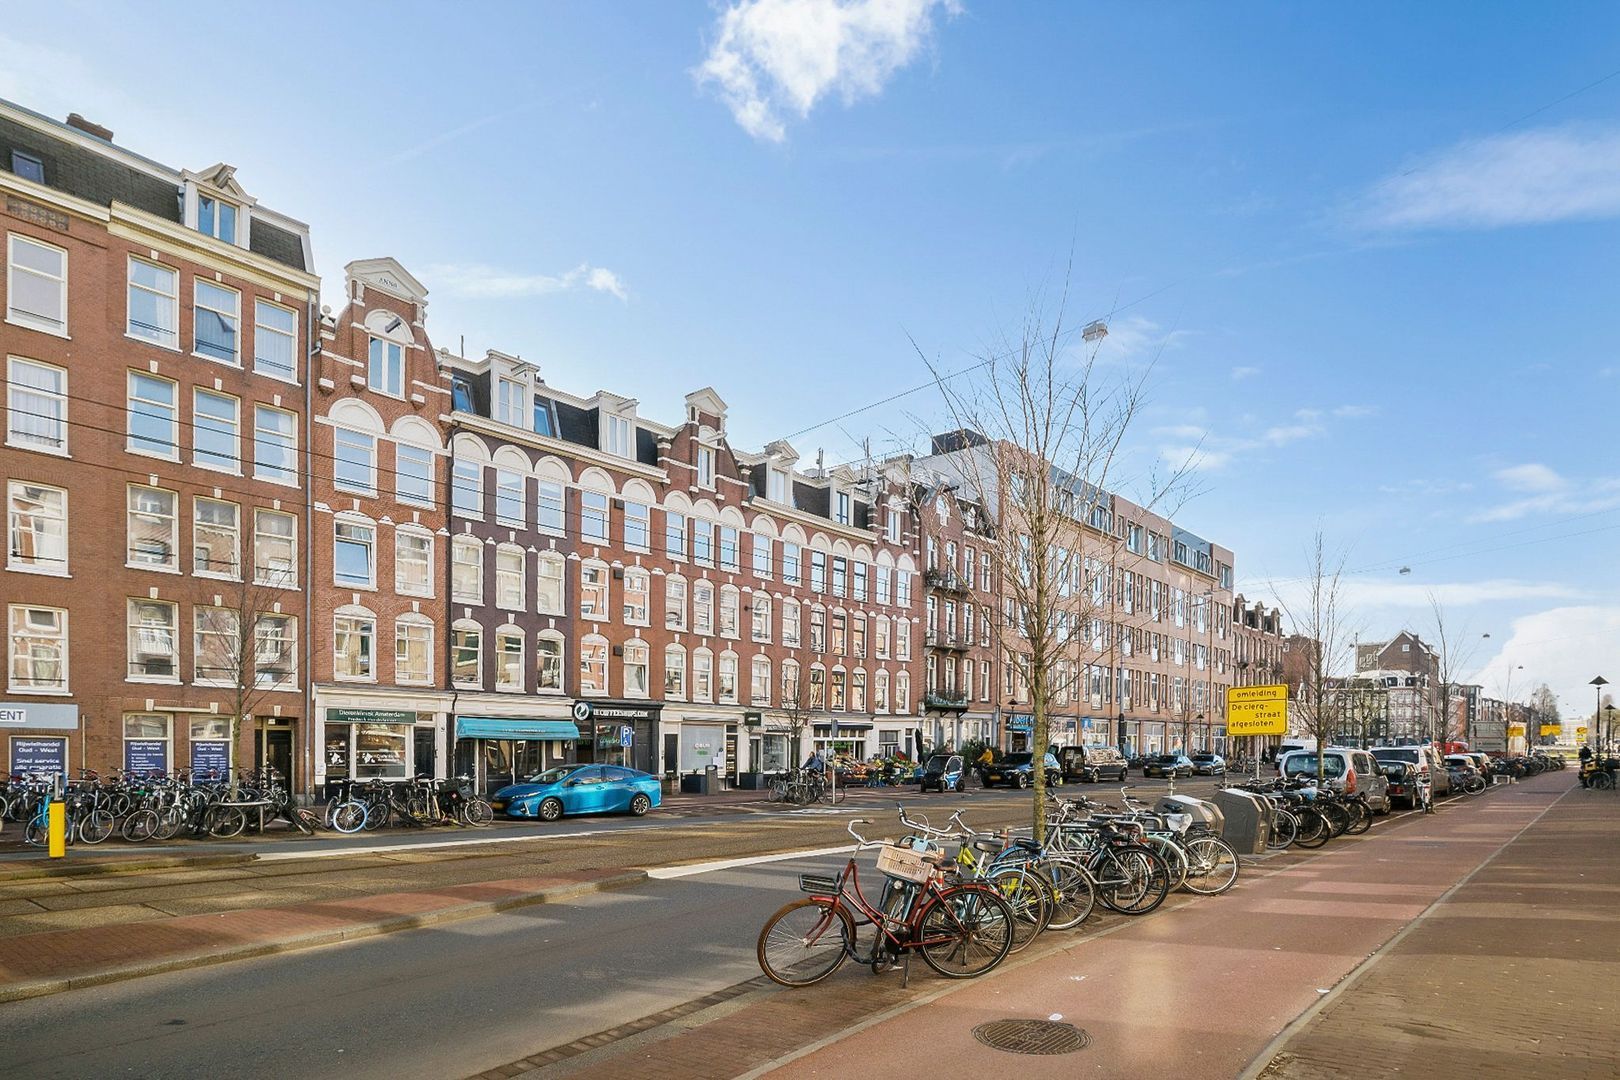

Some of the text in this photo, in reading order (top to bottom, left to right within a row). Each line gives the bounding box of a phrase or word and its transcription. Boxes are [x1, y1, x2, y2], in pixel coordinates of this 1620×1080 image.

[1236, 690, 1277, 698] omleiding
[1231, 720, 1274, 728] afgesloten
[624, 728, 630, 737] P
